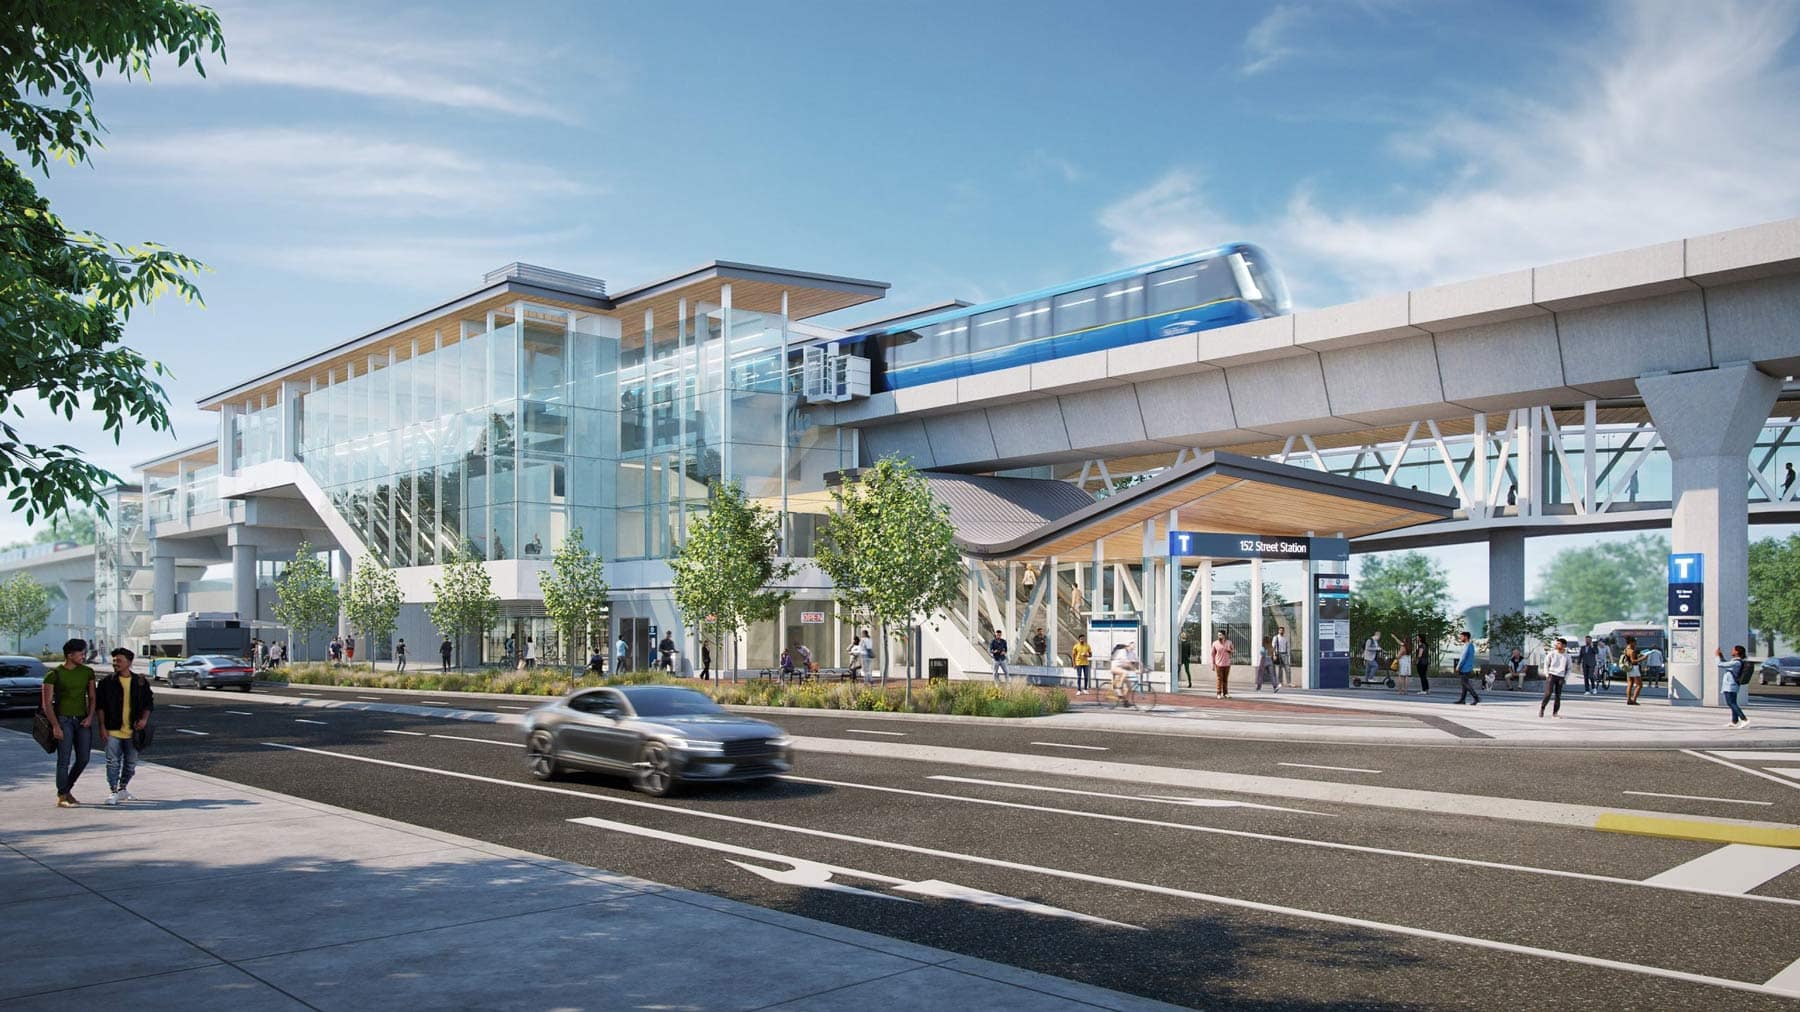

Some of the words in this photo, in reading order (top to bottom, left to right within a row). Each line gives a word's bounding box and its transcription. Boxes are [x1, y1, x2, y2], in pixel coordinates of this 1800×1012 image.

[1178, 535, 1190, 552] T
[1240, 540, 1254, 551] 152
[1255, 541, 1279, 552] Street
[1280, 542, 1307, 553] Station
[1675, 558, 1694, 578] T
